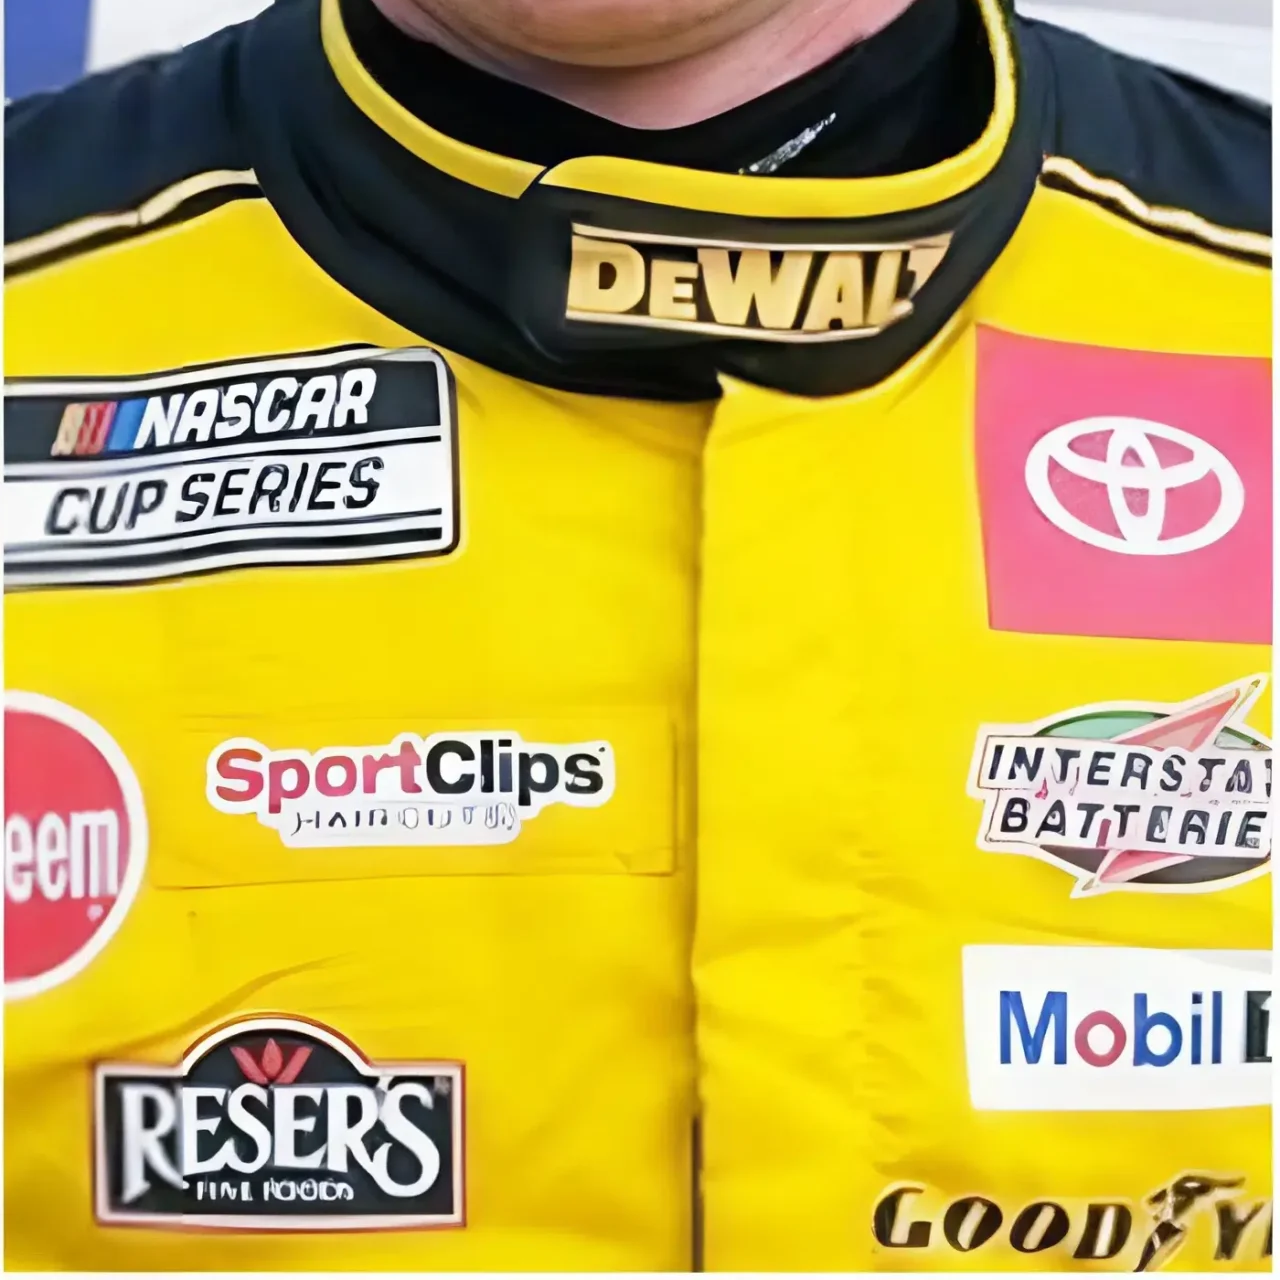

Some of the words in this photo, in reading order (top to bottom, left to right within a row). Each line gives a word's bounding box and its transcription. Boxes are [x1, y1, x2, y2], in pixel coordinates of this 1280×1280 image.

[134, 368, 376, 449] NASCAR
[45, 479, 168, 534] CUP
[175, 457, 385, 523] SERIES
[988, 744, 1272, 797] INTERSTA
[5, 809, 118, 903] eem
[1000, 990, 1222, 1067] Mobil
[874, 1187, 1272, 1260] GOODY
